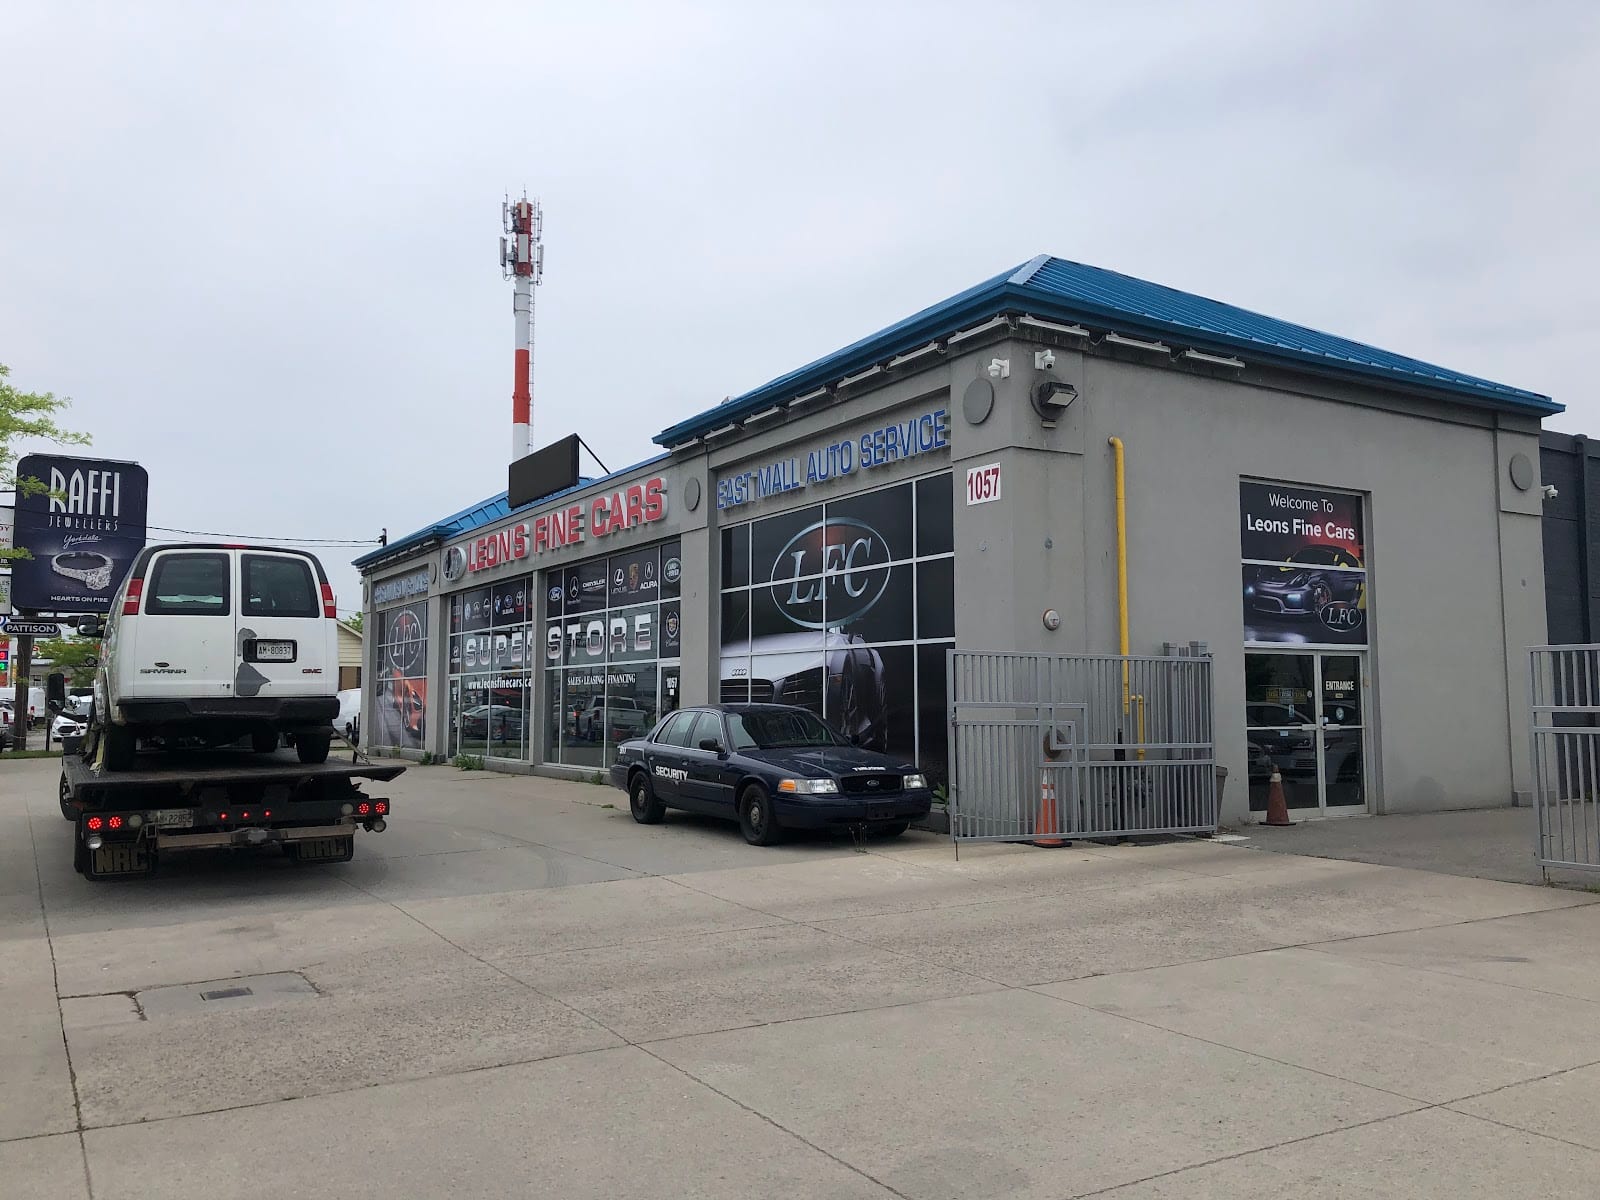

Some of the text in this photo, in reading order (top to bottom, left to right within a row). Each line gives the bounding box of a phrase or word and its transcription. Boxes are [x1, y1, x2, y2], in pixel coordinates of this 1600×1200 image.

[717, 409, 950, 510] EAST MALL AUTO SERVICE
[48, 466, 120, 517] RAFFI
[967, 467, 1000, 502] 1057
[1269, 493, 1334, 513] Welcome To
[48, 515, 119, 531] JEWELLERS
[535, 505, 584, 553] FINE
[591, 477, 666, 538] CARS
[1247, 513, 1355, 540] Leons Fine Cars
[786, 537, 872, 605] LFC
[640, 580, 657, 590] ACURA
[1327, 607, 1356, 625] LFC
[6, 624, 56, 633] PATTISON
[547, 613, 651, 659] STORE
[608, 673, 636, 684] FINANCING
[1325, 681, 1355, 691] ENTRANCE
[655, 765, 689, 781] SECURITY
